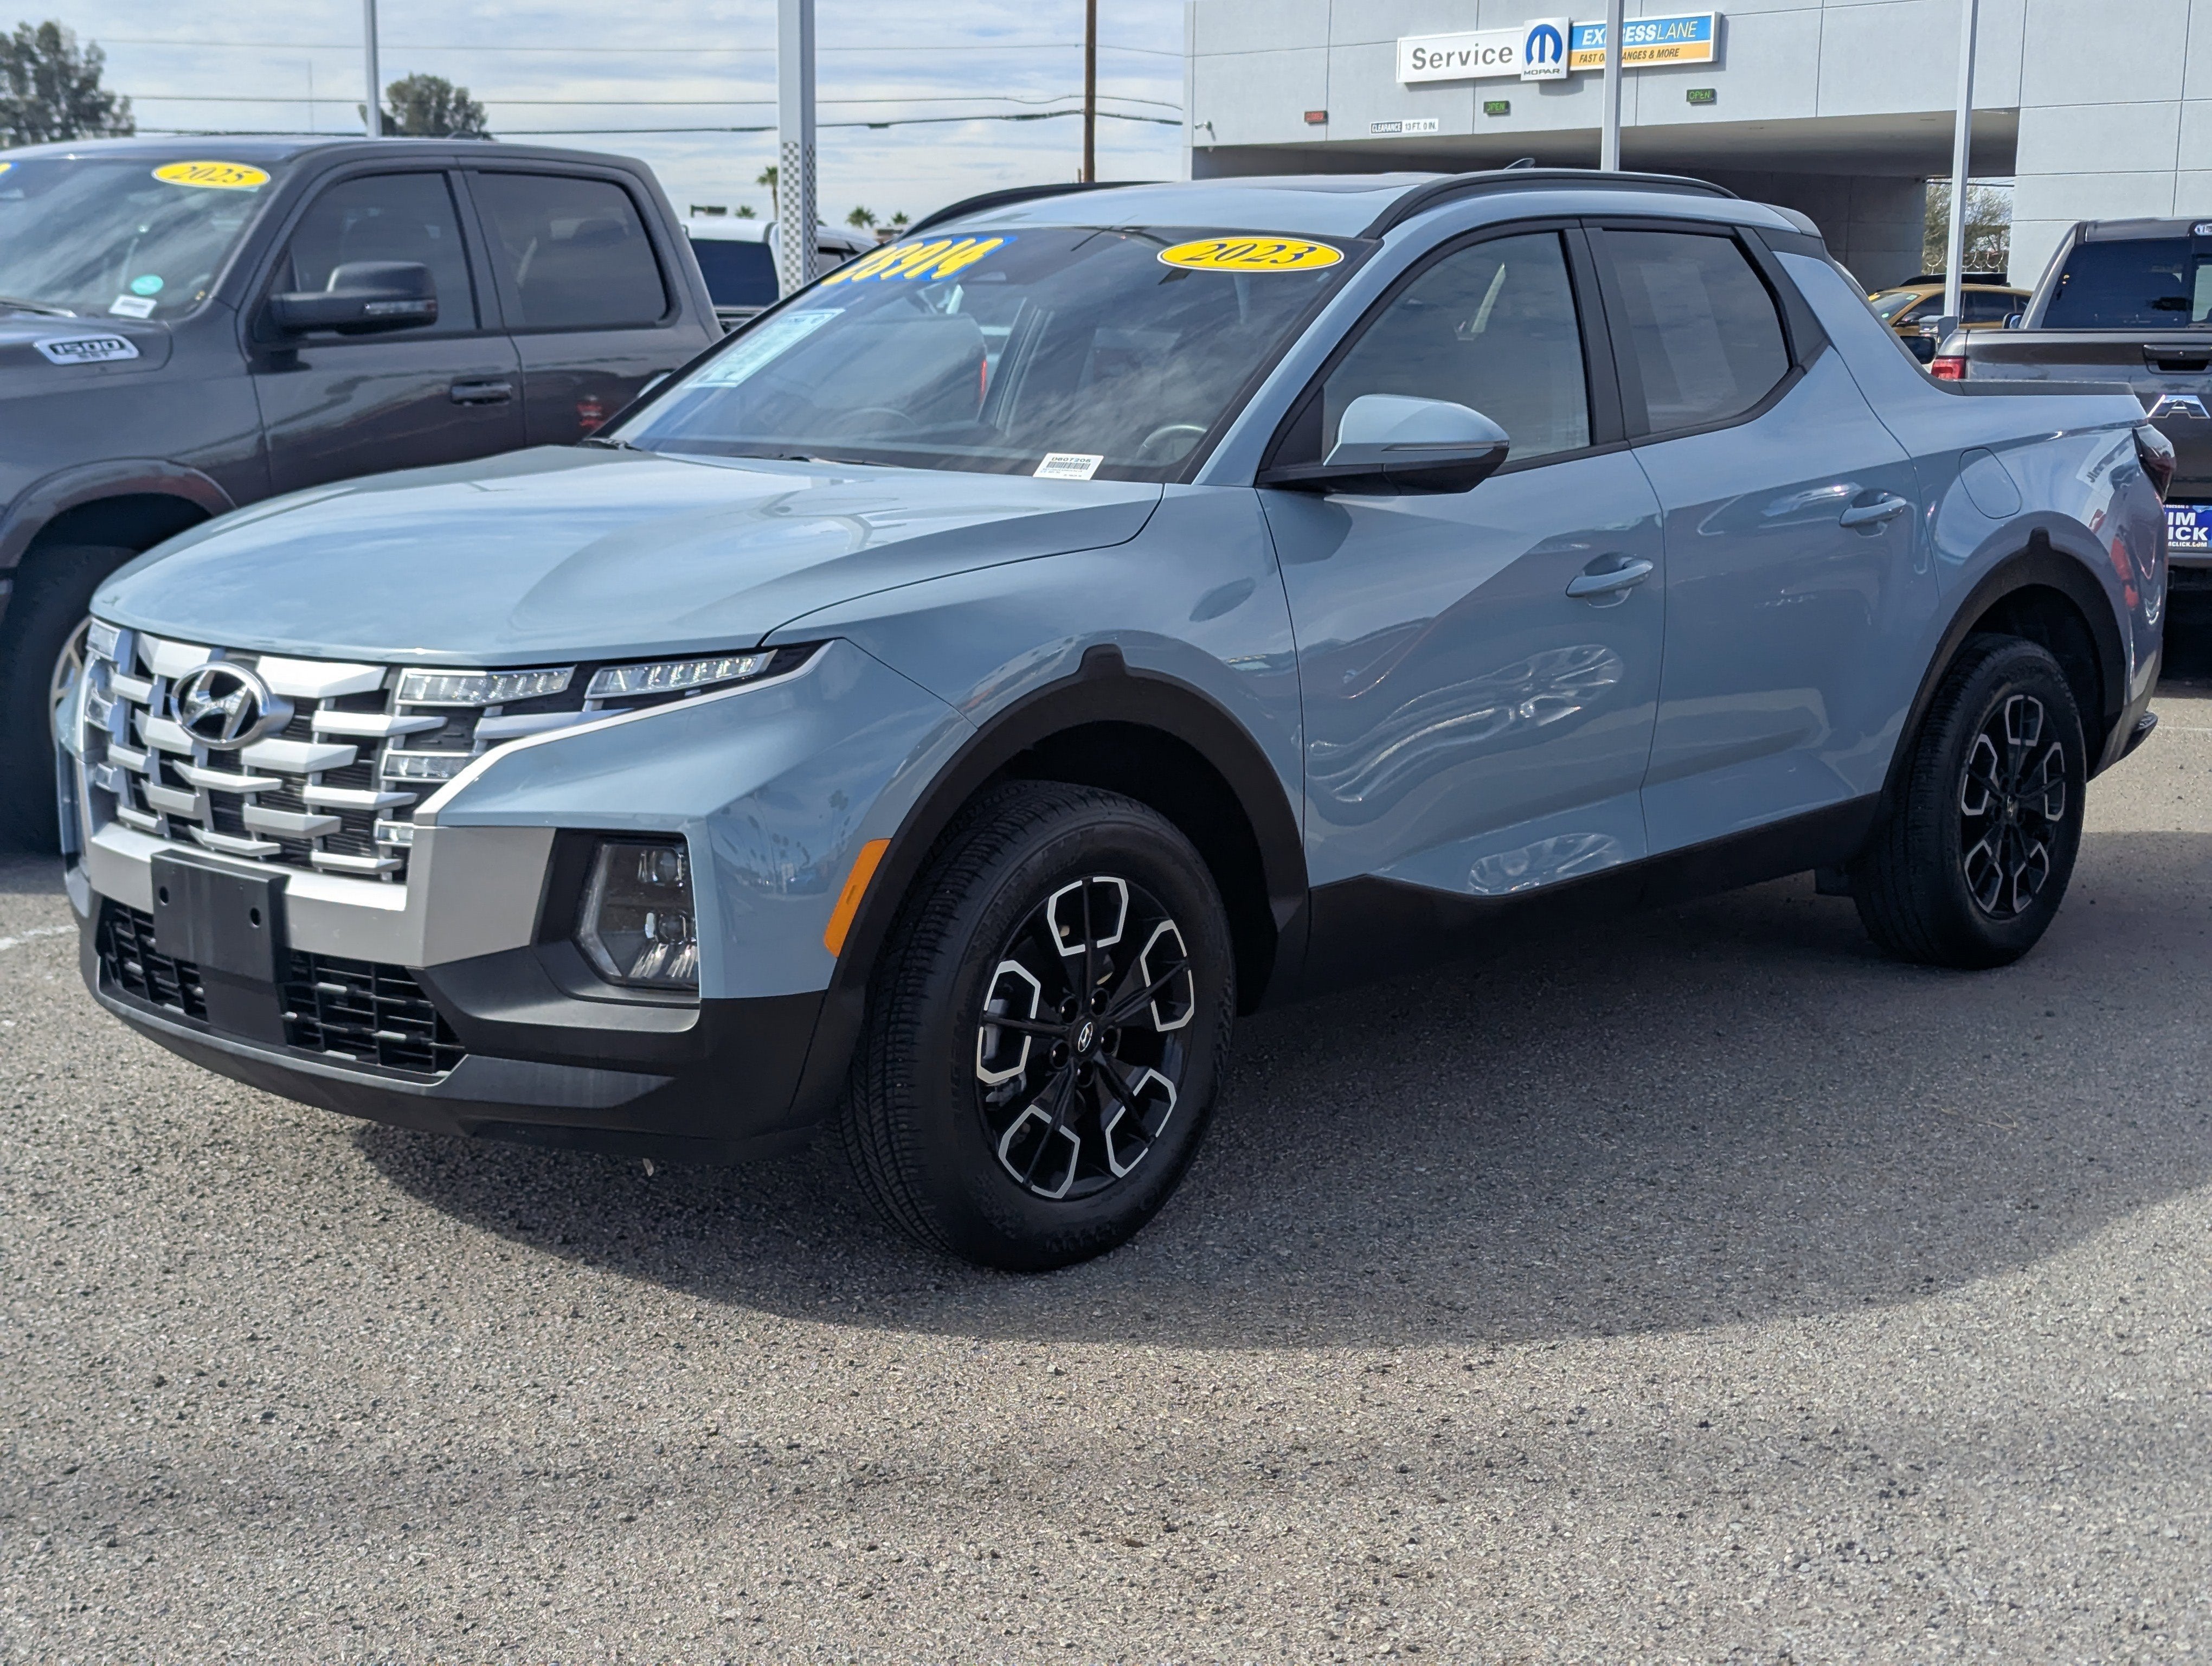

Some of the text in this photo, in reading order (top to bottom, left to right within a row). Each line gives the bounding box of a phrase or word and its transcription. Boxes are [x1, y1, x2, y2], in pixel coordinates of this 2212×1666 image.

[1412, 43, 1513, 70] Service
[1579, 53, 1598, 63] FAST
[1621, 50, 1647, 61] ANGES
[1648, 50, 1655, 59] &
[1656, 48, 1680, 58] MORE
[1689, 91, 1711, 99] OPEN
[1372, 123, 1401, 132] CLEARANCE
[168, 166, 253, 183] 2025
[1180, 243, 1318, 264] 2023
[55, 340, 120, 355] 1500
[2168, 511, 2196, 526] IM
